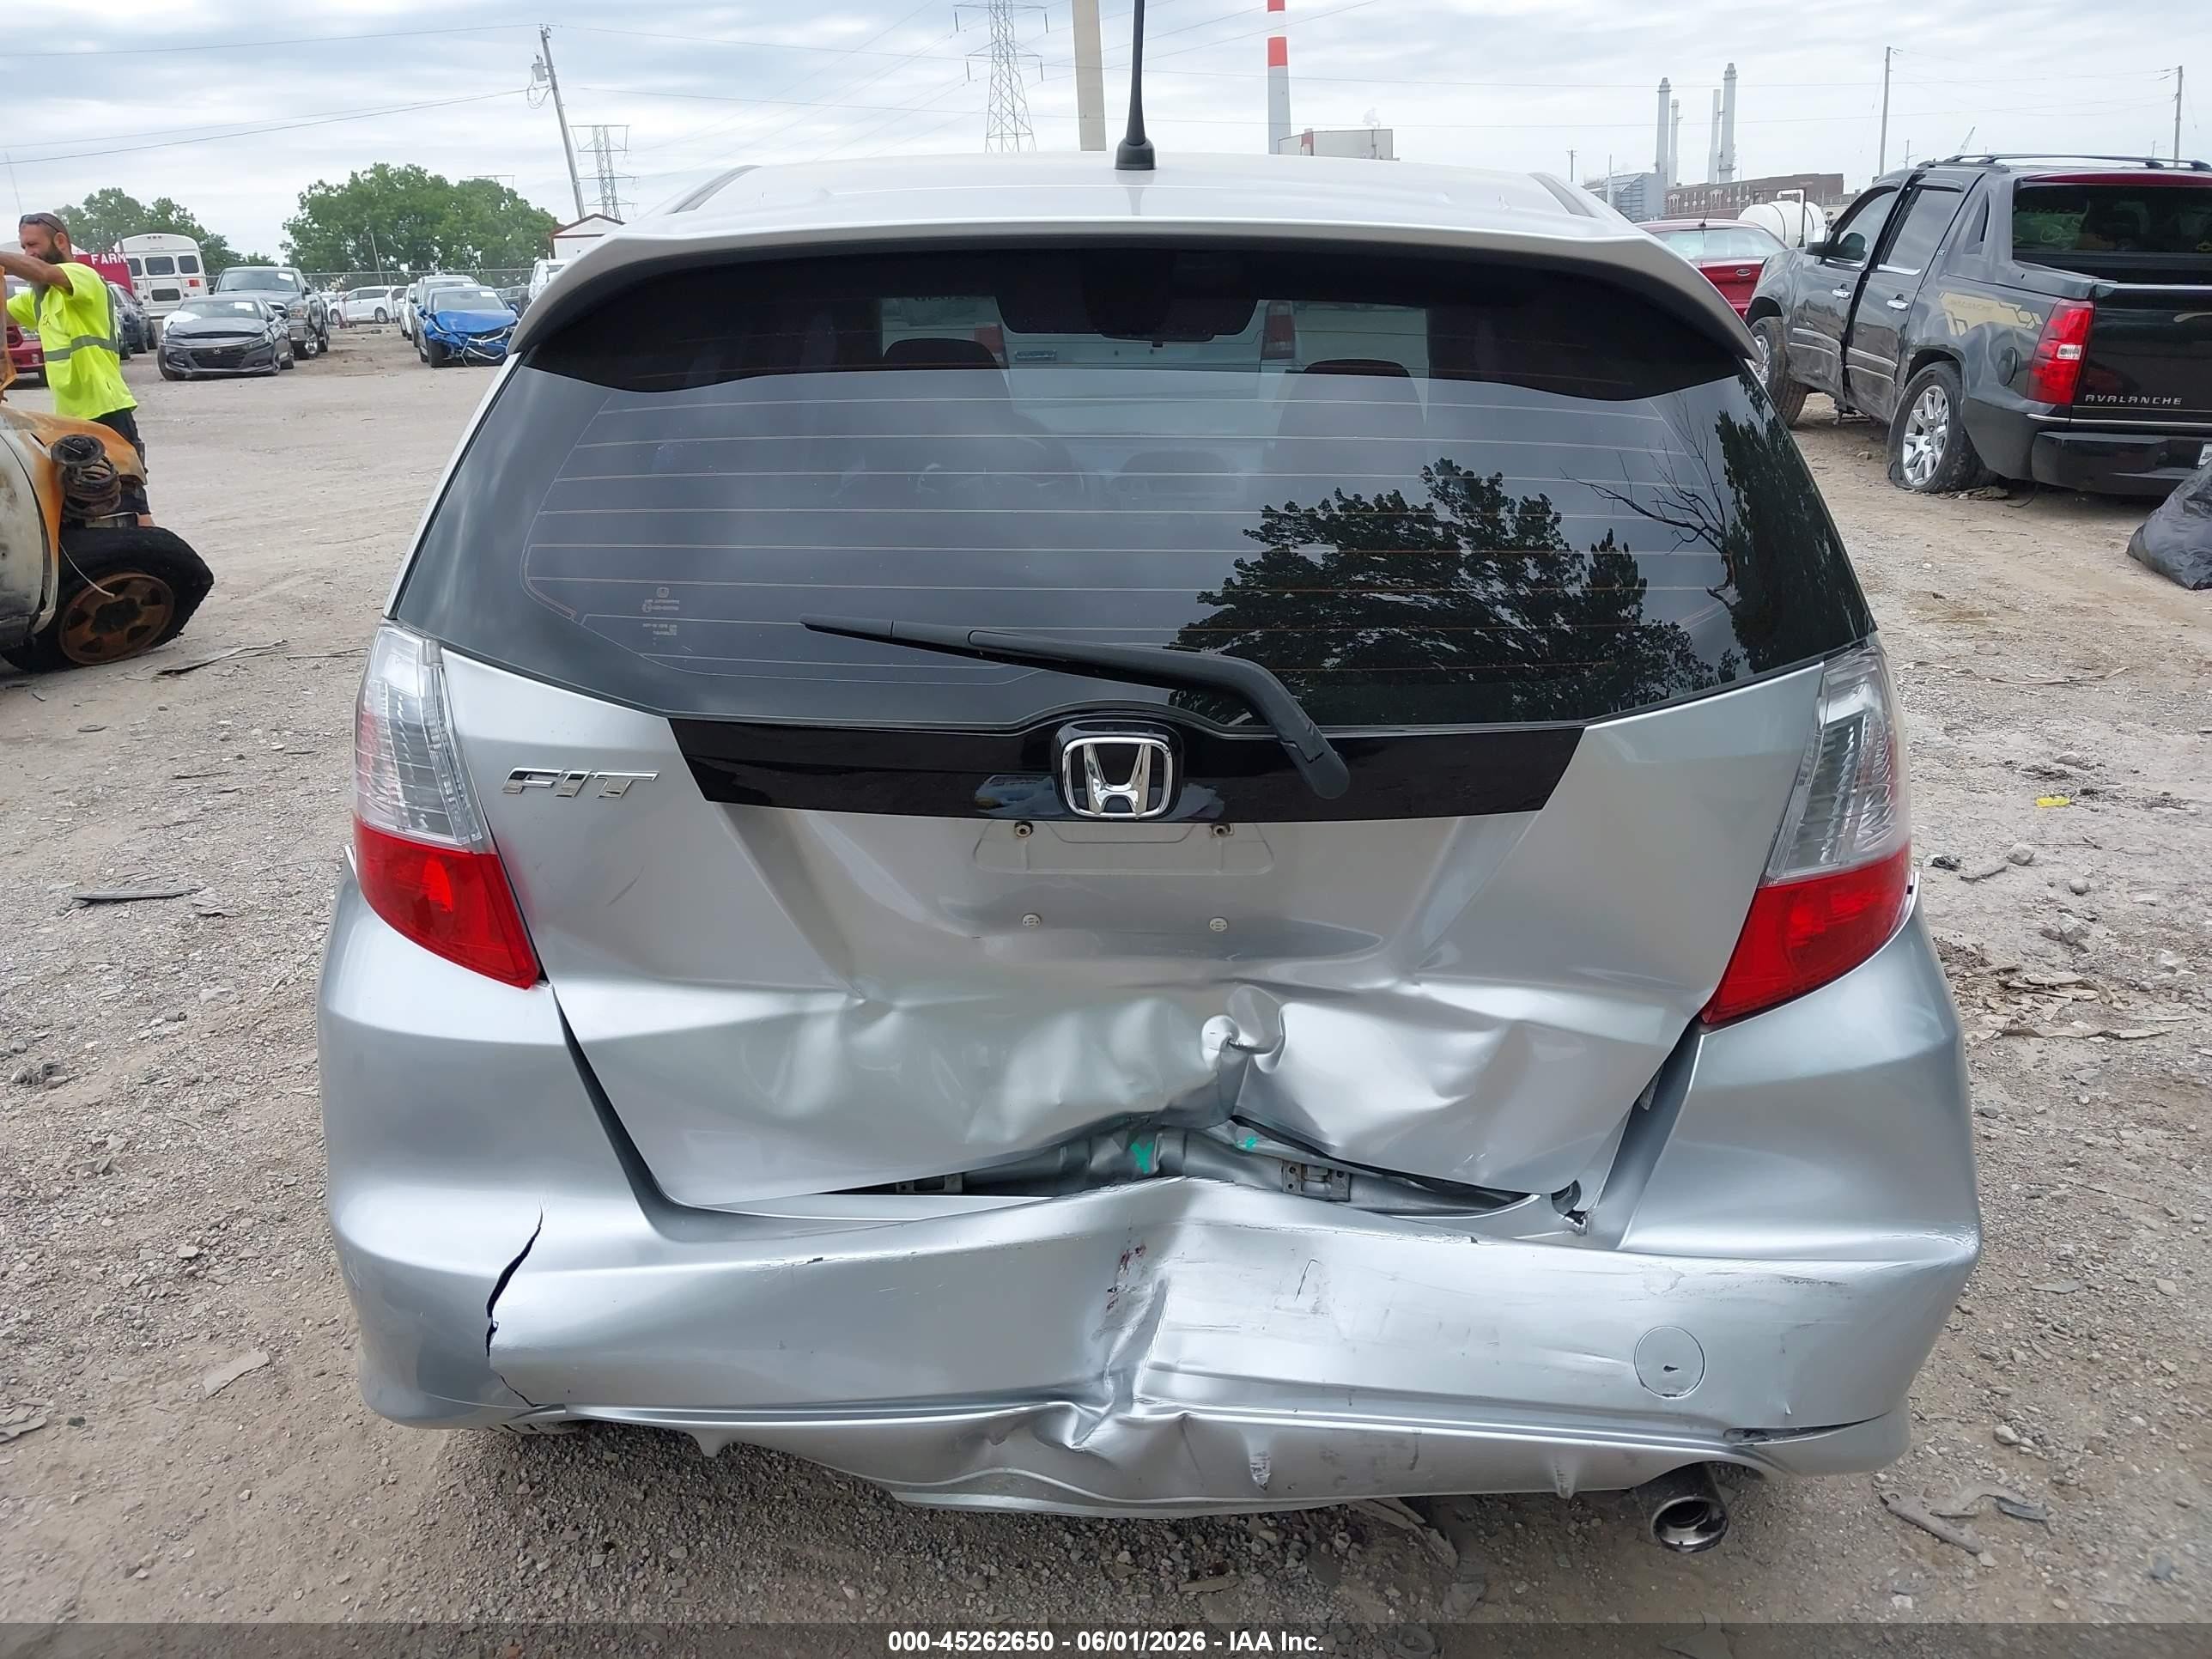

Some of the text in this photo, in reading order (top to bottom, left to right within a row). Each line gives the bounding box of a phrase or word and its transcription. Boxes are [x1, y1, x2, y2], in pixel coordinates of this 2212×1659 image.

[90, 252, 126, 265] FARM
[2084, 394, 2183, 405] AVALANCHE
[501, 766, 660, 799] FIT
